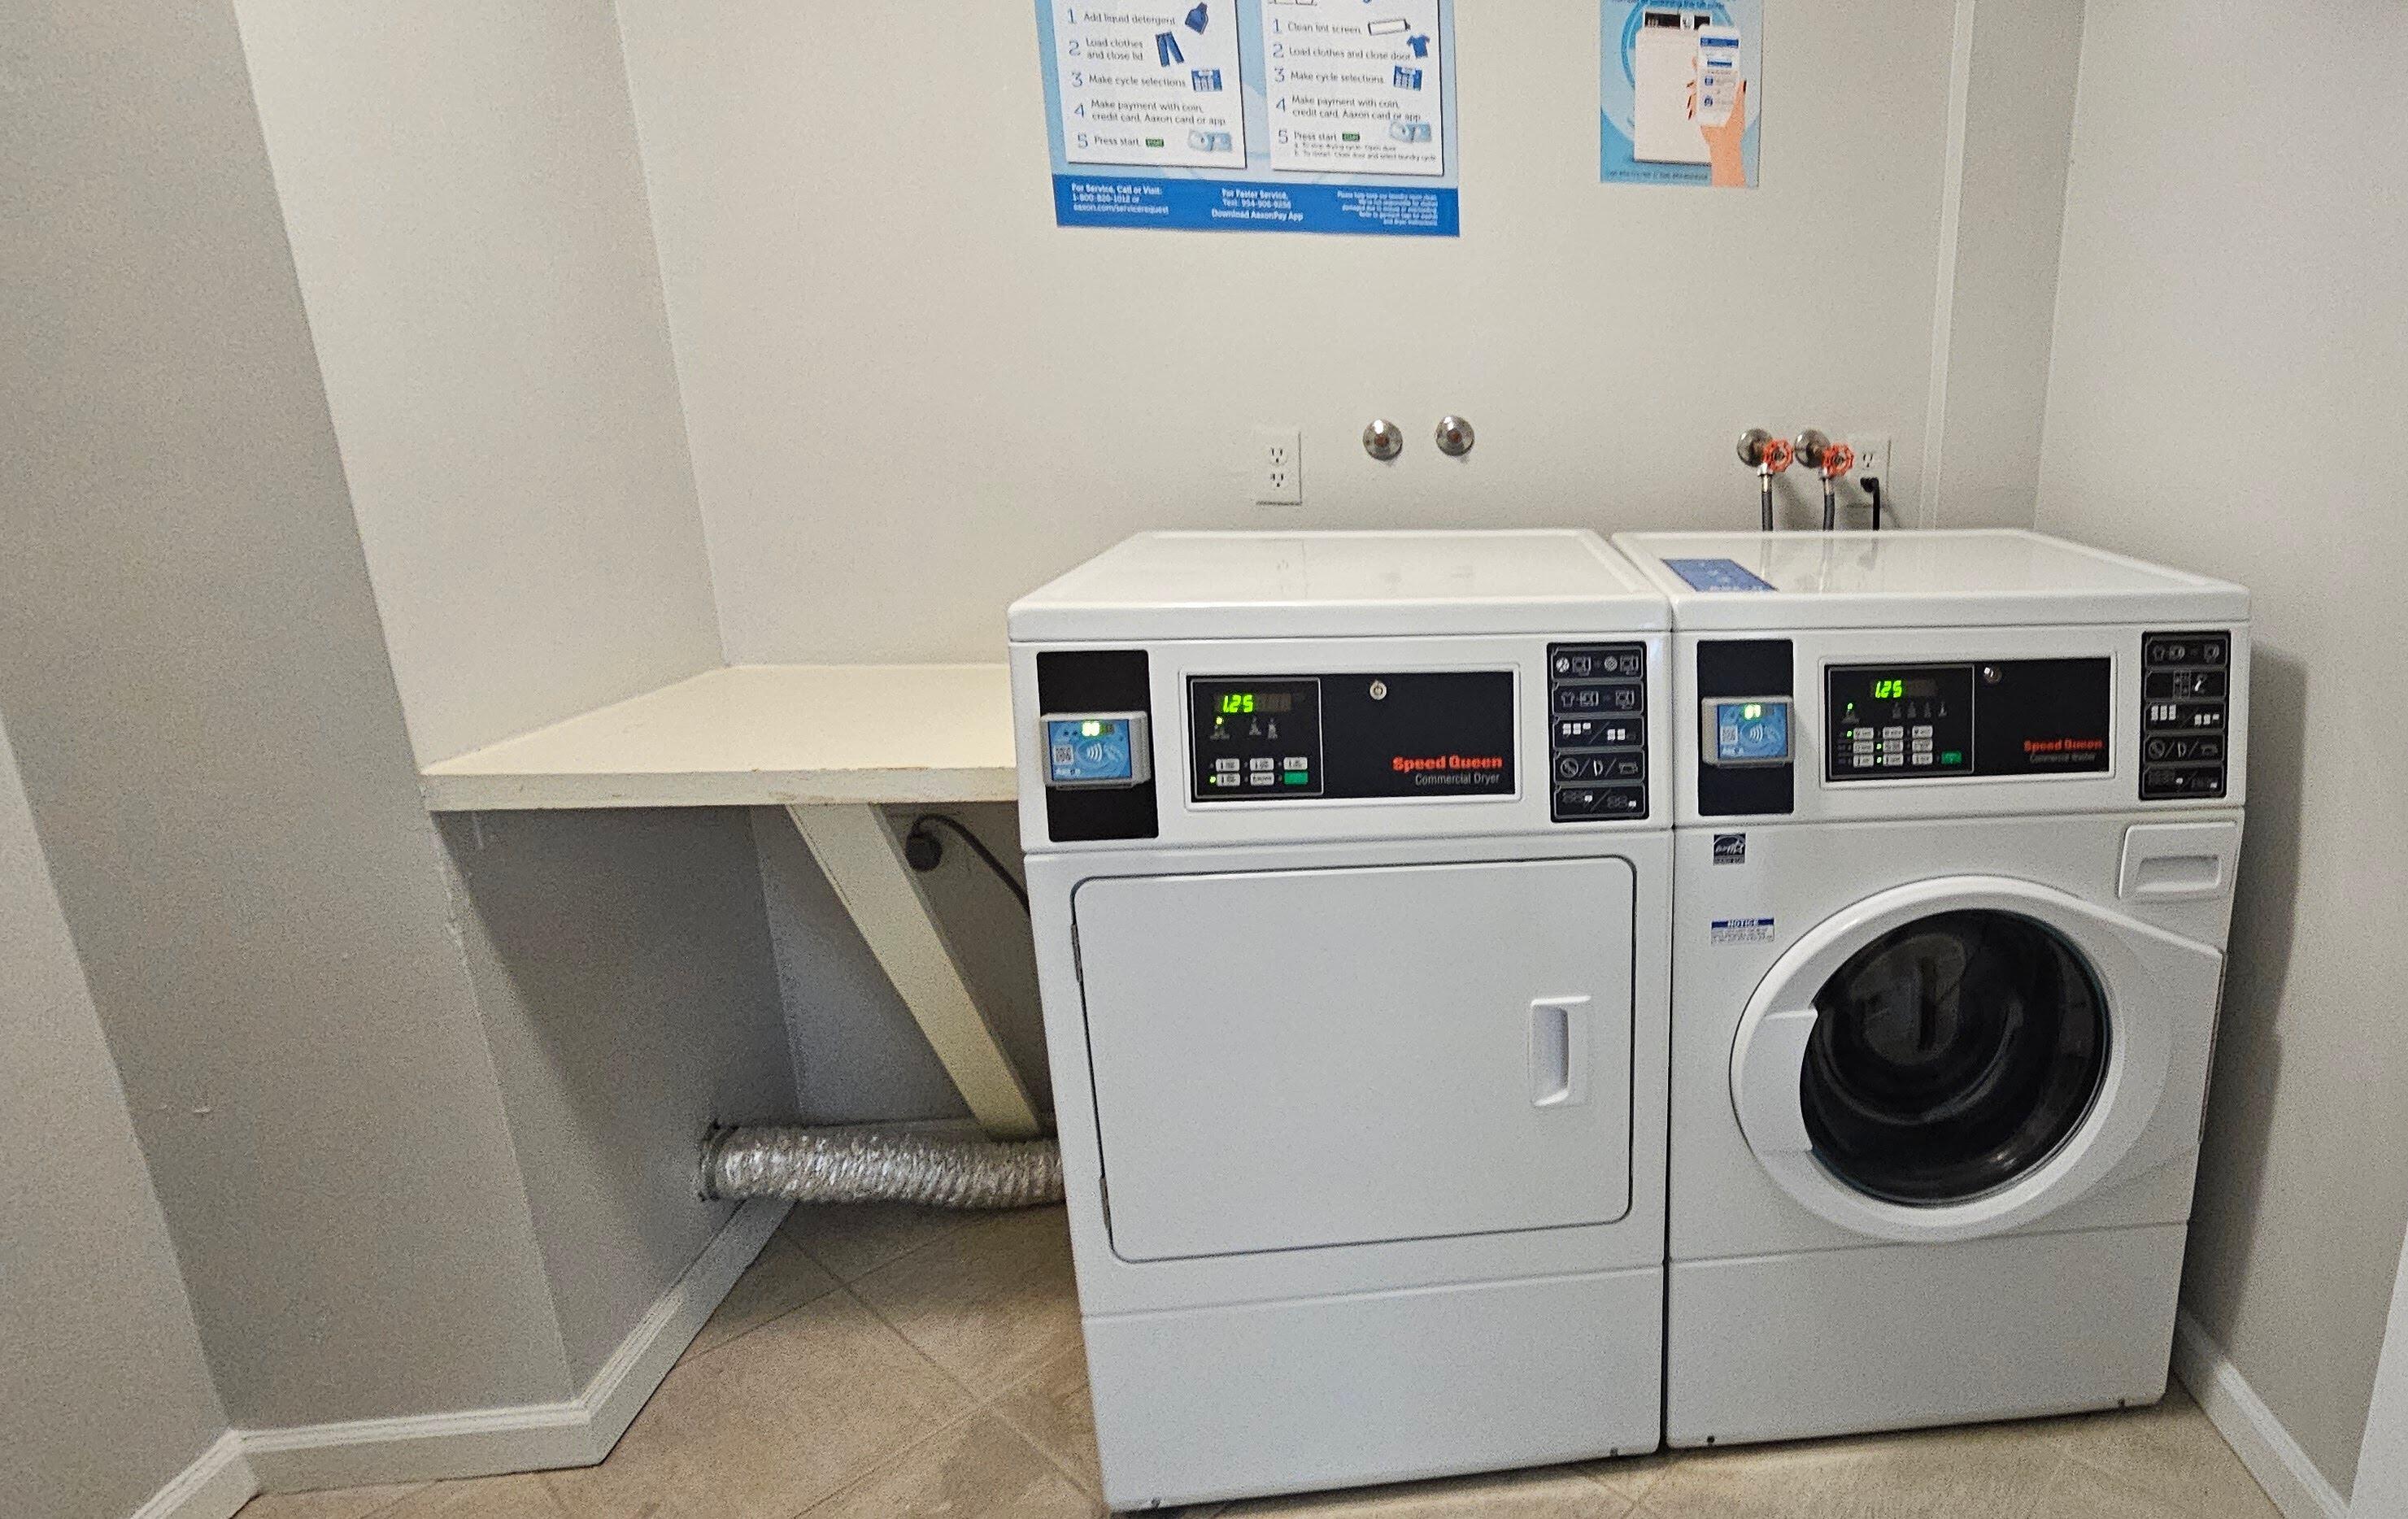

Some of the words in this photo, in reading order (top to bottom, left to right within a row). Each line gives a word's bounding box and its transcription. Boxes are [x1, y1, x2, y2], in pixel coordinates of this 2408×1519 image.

[1068, 7, 1076, 24] 1
[1084, 13, 1101, 22] Add
[1104, 13, 1129, 24] liquid
[1131, 15, 1175, 25] detergent
[1274, 19, 1282, 33] 1
[1287, 23, 1313, 32] Clean
[1069, 39, 1081, 56] 2
[1086, 38, 1108, 47] Load
[1110, 39, 1143, 48] clothes
[1274, 43, 1284, 58] 2
[1289, 47, 1311, 56] Load
[1313, 48, 1344, 58] clothes
[1348, 50, 1363, 59] and
[1366, 50, 1387, 59] close
[1391, 52, 1411, 61] door
[1087, 51, 1104, 59] and
[1106, 52, 1130, 60] close
[1132, 52, 1143, 60] lid
[1071, 72, 1083, 88] 3
[1089, 74, 1113, 83] Make
[1115, 76, 1138, 86] cycle
[1141, 77, 1186, 87] selections
[1274, 67, 1285, 82] 3
[1291, 72, 1313, 81] Make
[1316, 72, 1338, 82] cycle
[1341, 74, 1384, 84] selections
[1074, 103, 1085, 118] 4
[1091, 99, 1115, 109] Make
[1118, 102, 1156, 111] payment
[1160, 102, 1179, 111] with
[1276, 98, 1286, 113] 4
[1291, 95, 1314, 105] Make
[1317, 97, 1356, 107] payment
[1358, 98, 1377, 107] with
[1092, 113, 1117, 121] credit
[1174, 115, 1194, 124] card
[1292, 108, 1317, 117] credit
[1372, 111, 1391, 120] card
[1078, 133, 1088, 149] 5
[1094, 136, 1117, 145] Press
[1278, 128, 1288, 143] 5
[1295, 131, 1315, 141] Press
[1071, 183, 1084, 192] For
[1117, 185, 1132, 194] Call
[1134, 186, 1142, 194] or
[1222, 188, 1234, 197] For
[1236, 188, 1258, 198] Faster
[1212, 208, 1250, 219] Download
[1288, 211, 1304, 222] App
[2024, 739, 2062, 753] Speed
[1392, 755, 1446, 773] Speed
[1448, 755, 1503, 769] Queen
[1415, 773, 1471, 786] Commercial
[1474, 773, 1500, 785] Dryer
